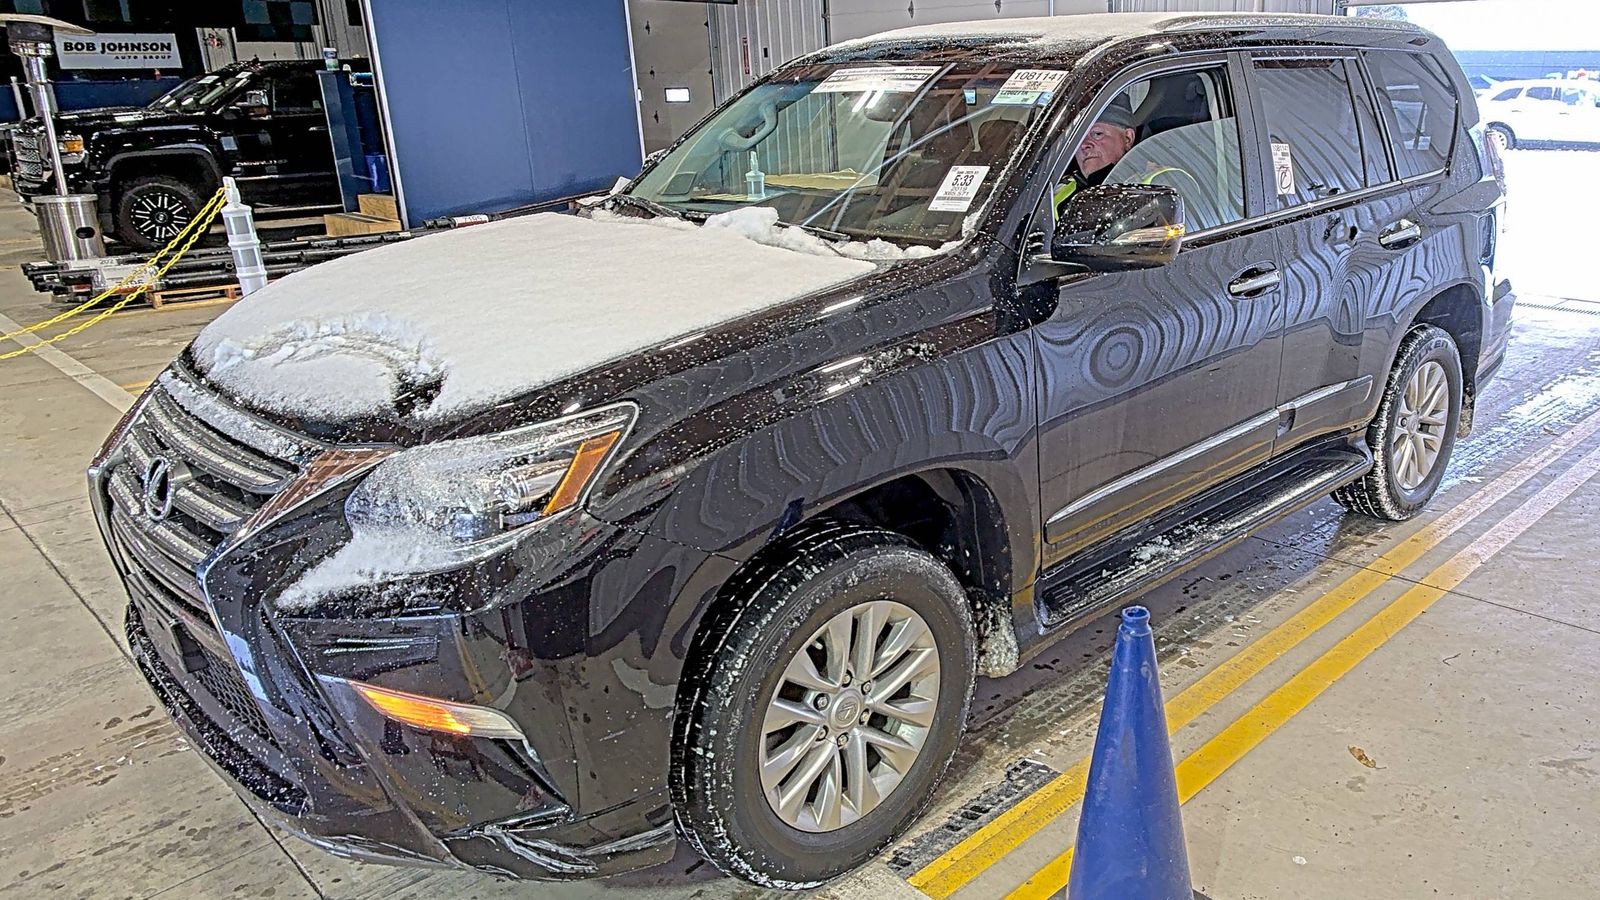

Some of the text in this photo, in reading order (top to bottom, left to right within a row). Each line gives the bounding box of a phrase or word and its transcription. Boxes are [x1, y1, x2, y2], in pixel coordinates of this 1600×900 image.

[64, 42, 172, 54] BOB JOHNSON
[1014, 71, 1065, 81] 1081141
[951, 174, 975, 186] 5:33
